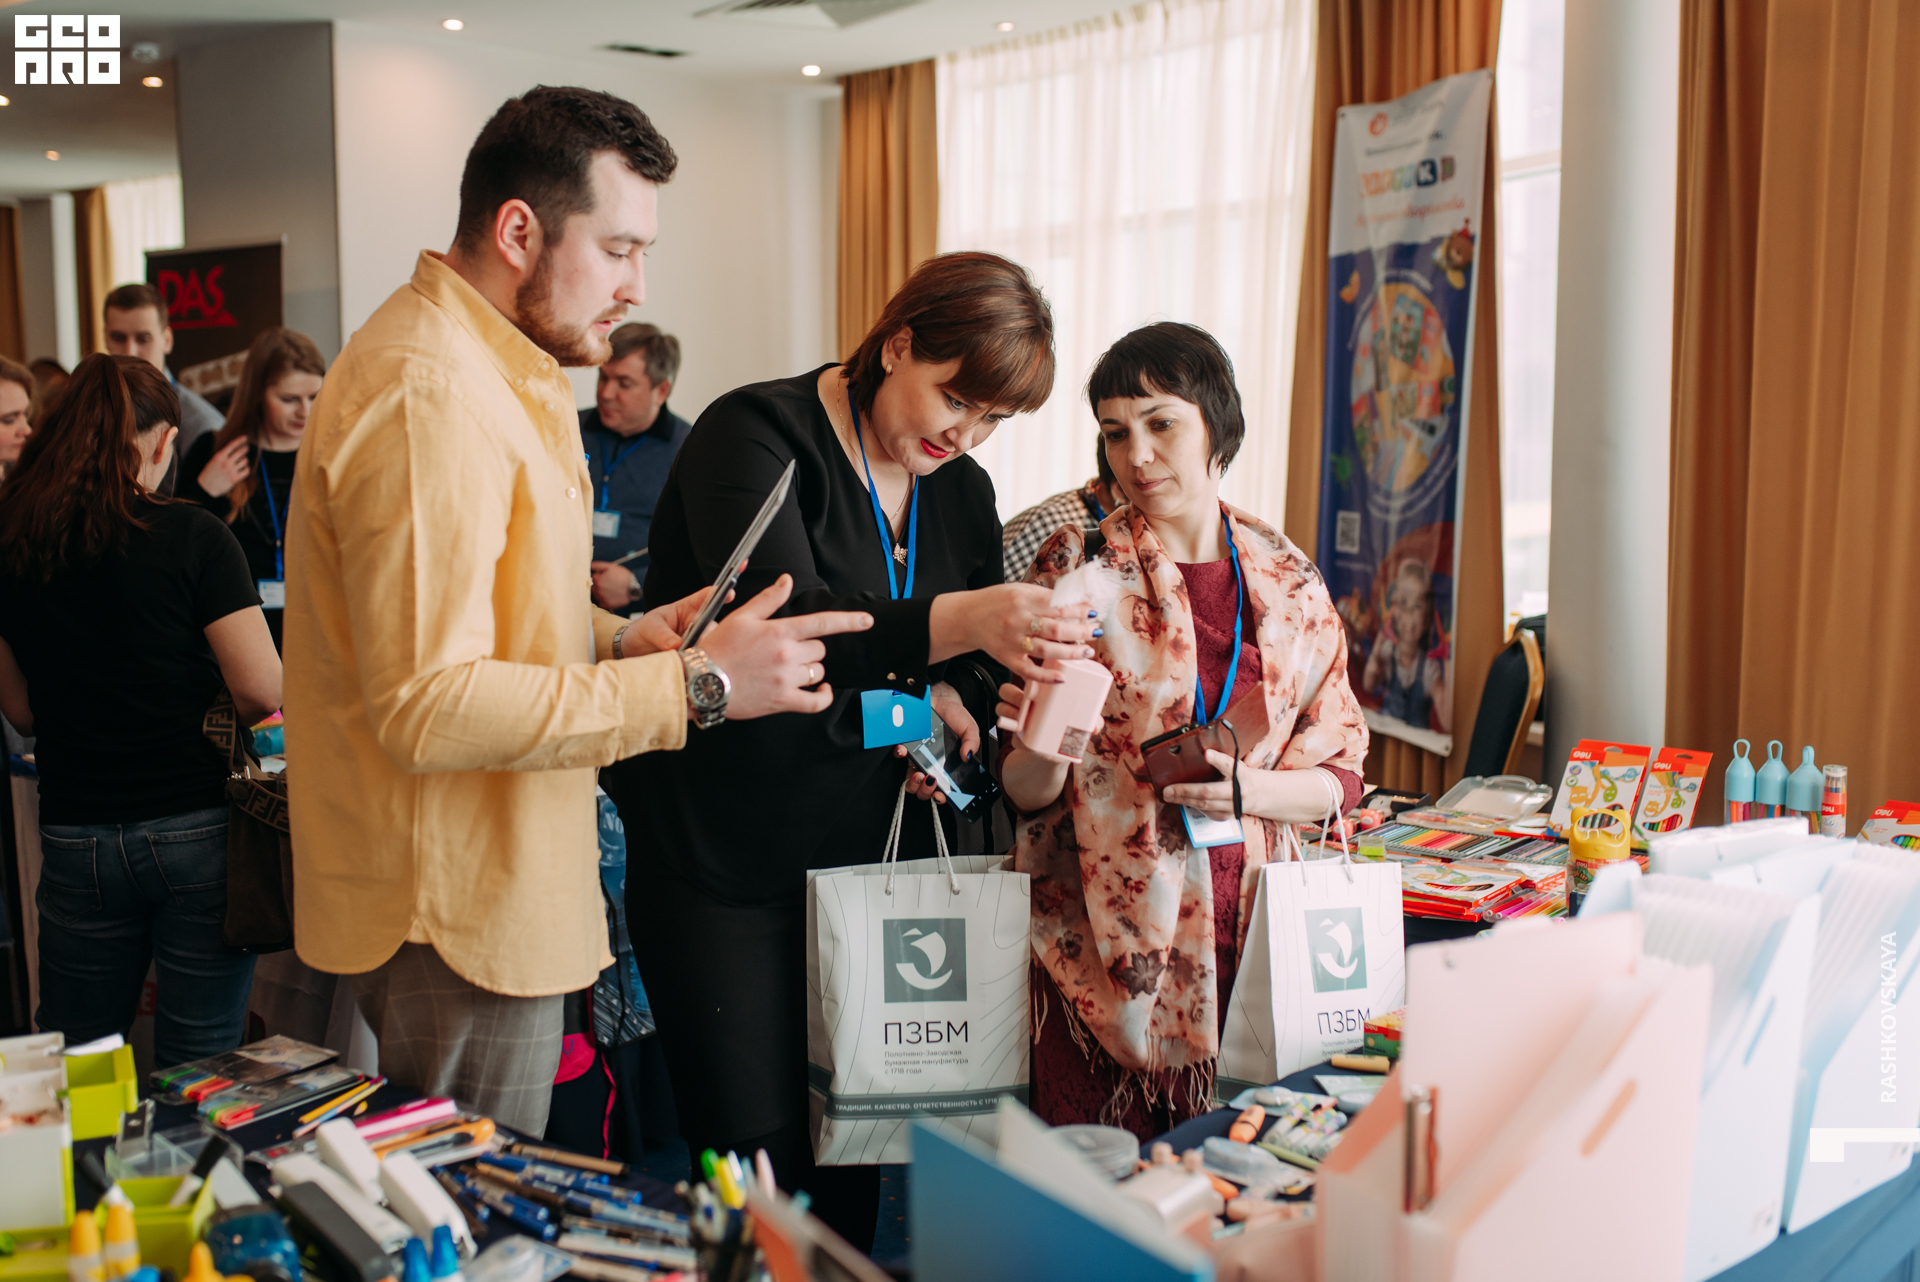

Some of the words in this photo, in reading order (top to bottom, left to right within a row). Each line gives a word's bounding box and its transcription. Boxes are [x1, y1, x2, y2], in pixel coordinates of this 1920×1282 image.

[158, 265, 224, 318] DAS
[884, 1020, 969, 1045] ПЗБМ
[1317, 1007, 1370, 1035] ПЗБМ
[921, 1058, 969, 1066] мануфактура
